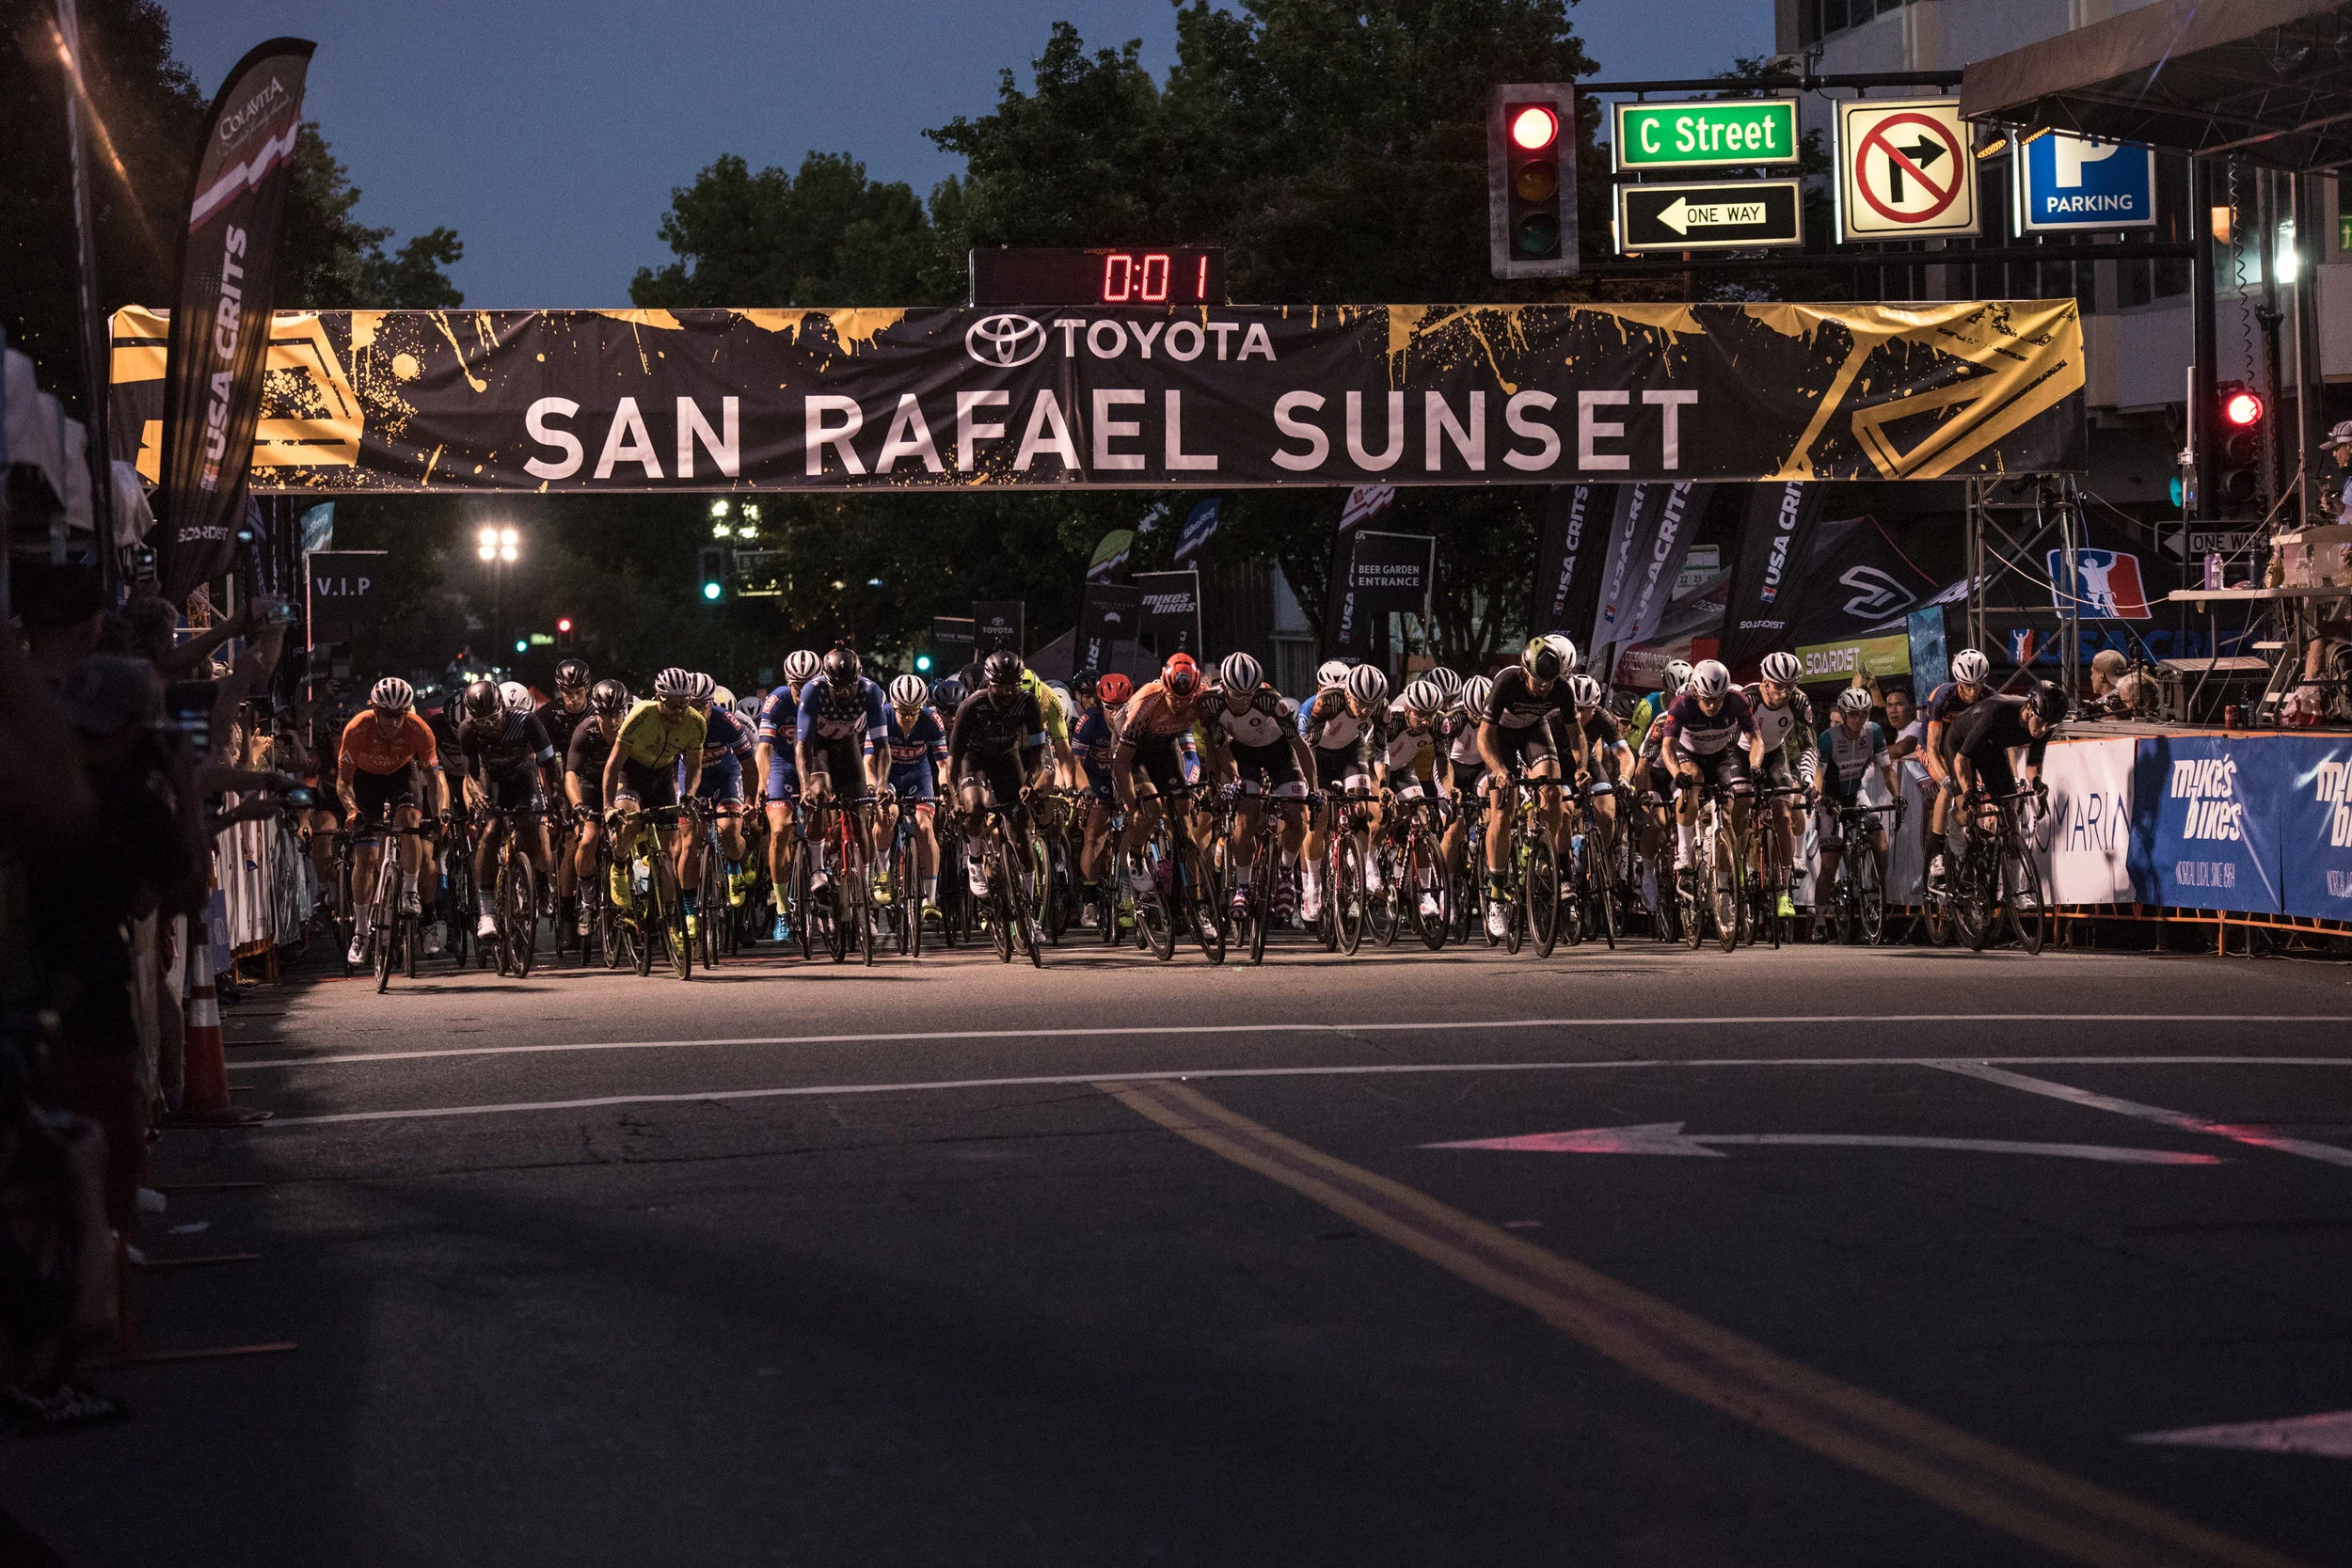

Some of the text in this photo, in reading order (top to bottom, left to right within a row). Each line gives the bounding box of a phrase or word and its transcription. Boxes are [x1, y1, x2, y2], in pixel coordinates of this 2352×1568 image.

[219, 76, 284, 140] COLAVITA
[1641, 114, 1776, 152] C Street
[1687, 204, 1760, 225] ONE WAY
[2046, 194, 2134, 214] PARKING
[206, 224, 247, 461] USA CRITS
[1054, 319, 1277, 361] TOYOTA
[523, 388, 1700, 480] SAN RAFAEL SUNSET
[1625, 483, 1648, 539] CRIT
[1654, 483, 1692, 562] CRITS
[1557, 484, 1589, 601] USA CRITS
[1765, 482, 1804, 587] USA CRIT
[2193, 534, 2224, 550] ONE
[1359, 565, 1420, 575] BEER GARDEN
[1359, 577, 1420, 587] ENTRANCE
[1739, 620, 1786, 630] SOARDIST
[1805, 647, 1861, 676] SOARDIST
